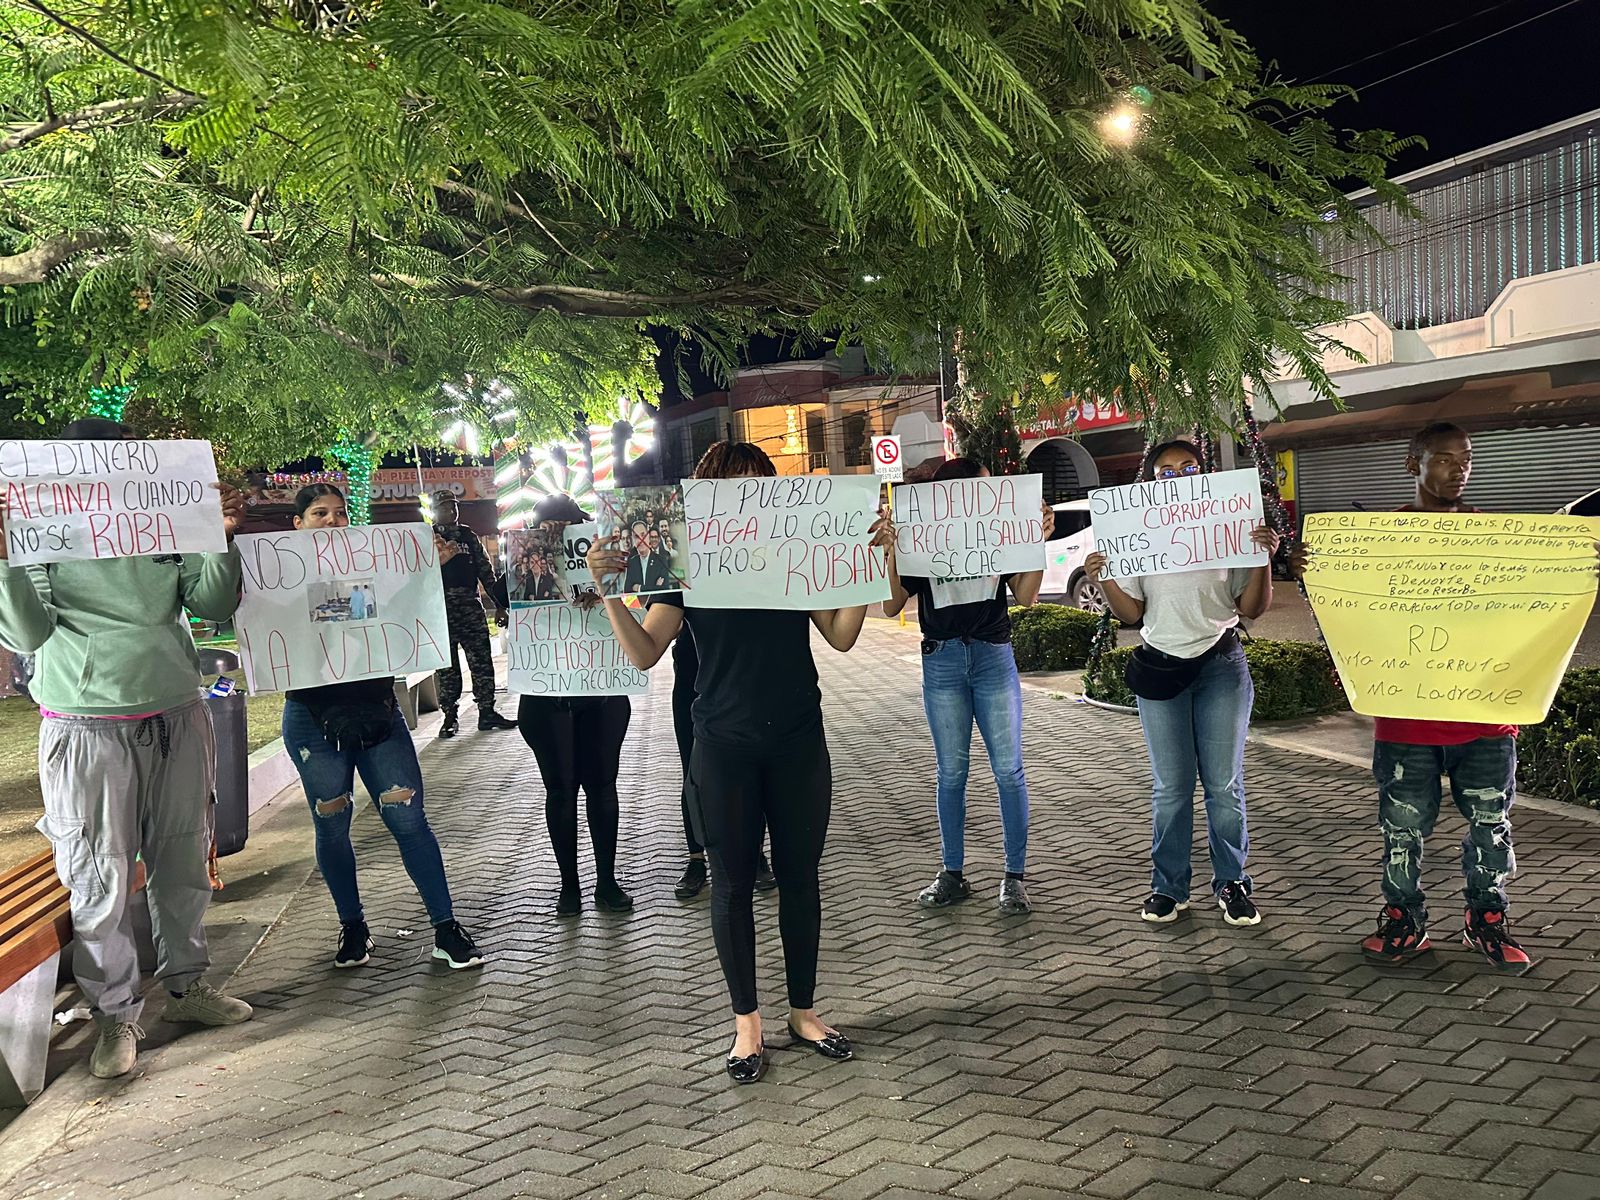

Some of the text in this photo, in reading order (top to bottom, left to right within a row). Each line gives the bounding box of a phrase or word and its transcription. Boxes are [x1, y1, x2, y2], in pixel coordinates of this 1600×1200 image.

[0, 440, 159, 478] EL DINERO
[6, 479, 204, 520] ALCANZA CUANDO
[685, 476, 833, 520] EL PUEBLO
[894, 478, 1017, 524] LA DEUDA
[1091, 475, 1213, 516] SILENCIA LA
[9, 512, 177, 558] NO SE ROBA
[687, 510, 863, 546] PAGA LO QUE
[896, 518, 1044, 555] CRECE LA SALUD
[1502, 518, 1524, 534] RD
[233, 527, 436, 594] NOS ROBARON
[929, 548, 1003, 578] SE CAE
[1097, 532, 1151, 558] ANTES
[1567, 539, 1591, 551] que
[776, 537, 888, 596] ROBAN
[1099, 560, 1115, 580] DE
[1120, 554, 1147, 578] QUE
[1146, 552, 1169, 571] TE
[1333, 560, 1370, 571] debe
[244, 617, 445, 693] LA VIDA
[510, 643, 550, 672] LUJO
[1408, 624, 1450, 657] RD
[531, 667, 650, 694] SIN RECURSOS
